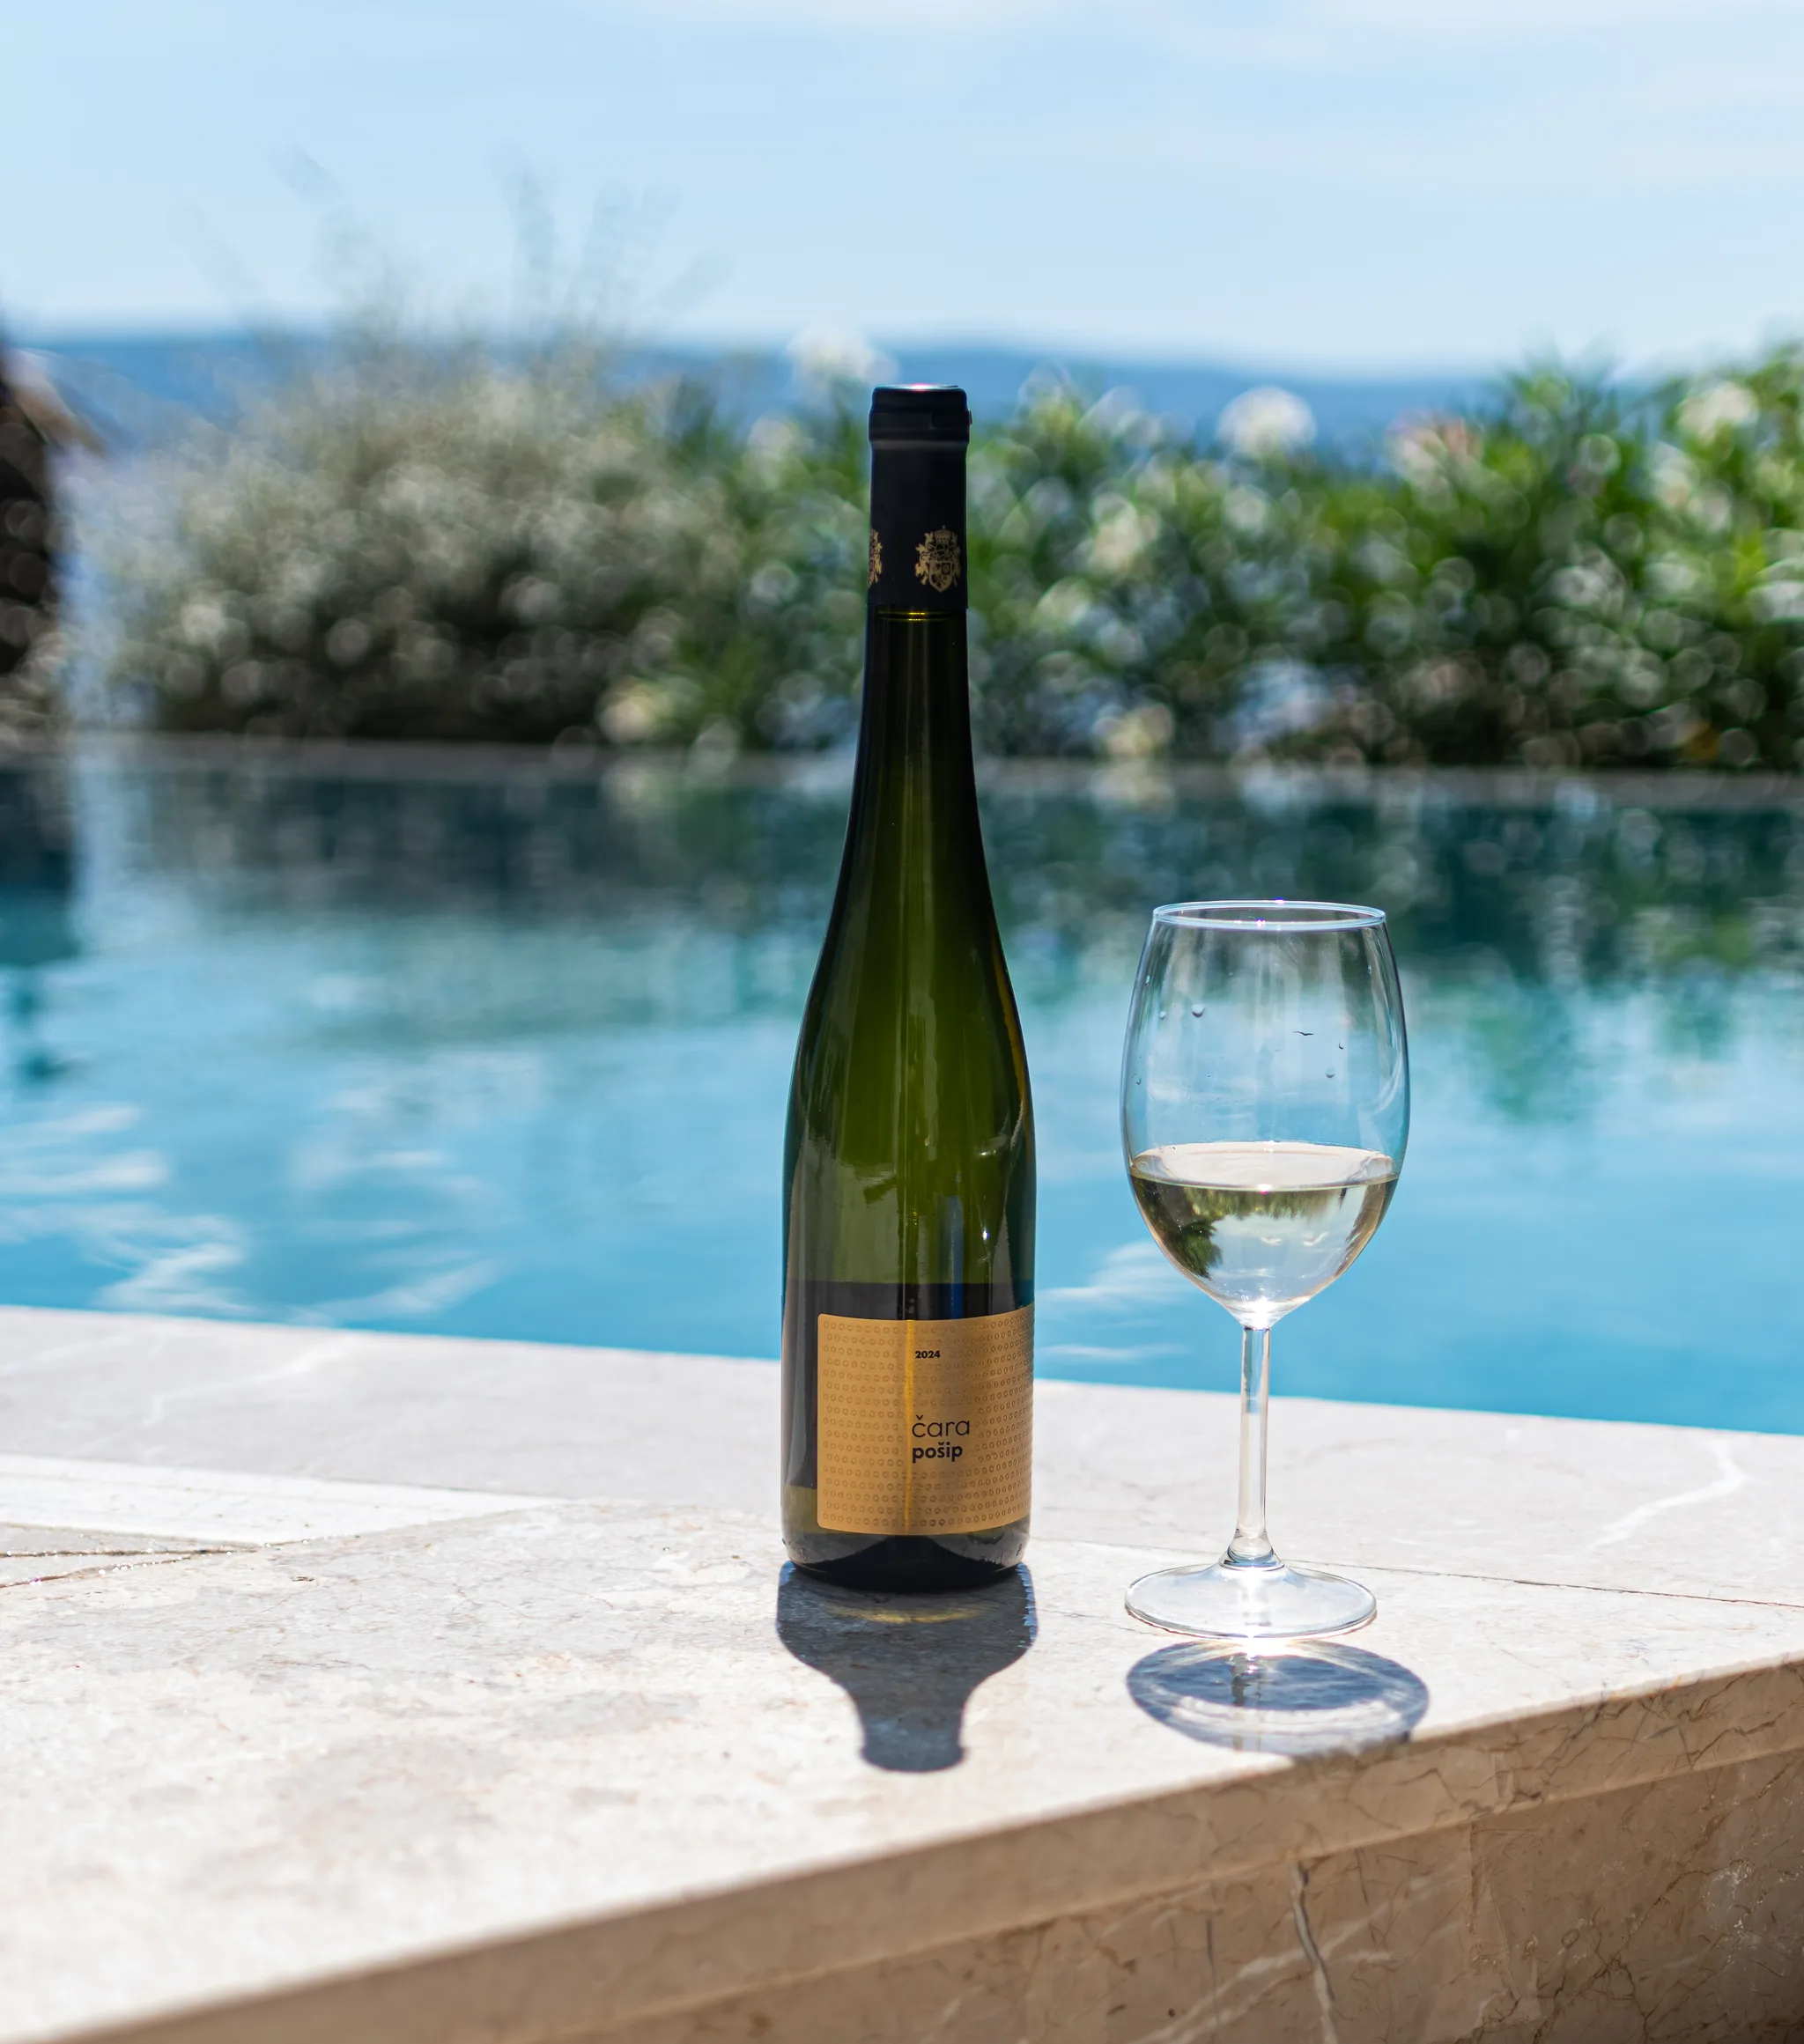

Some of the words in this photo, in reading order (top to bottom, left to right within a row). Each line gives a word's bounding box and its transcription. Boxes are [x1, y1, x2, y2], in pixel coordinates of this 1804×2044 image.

[914, 1350, 941, 1359] 2024
[912, 1414, 970, 1438] čara
[912, 1442, 963, 1464] pošip
